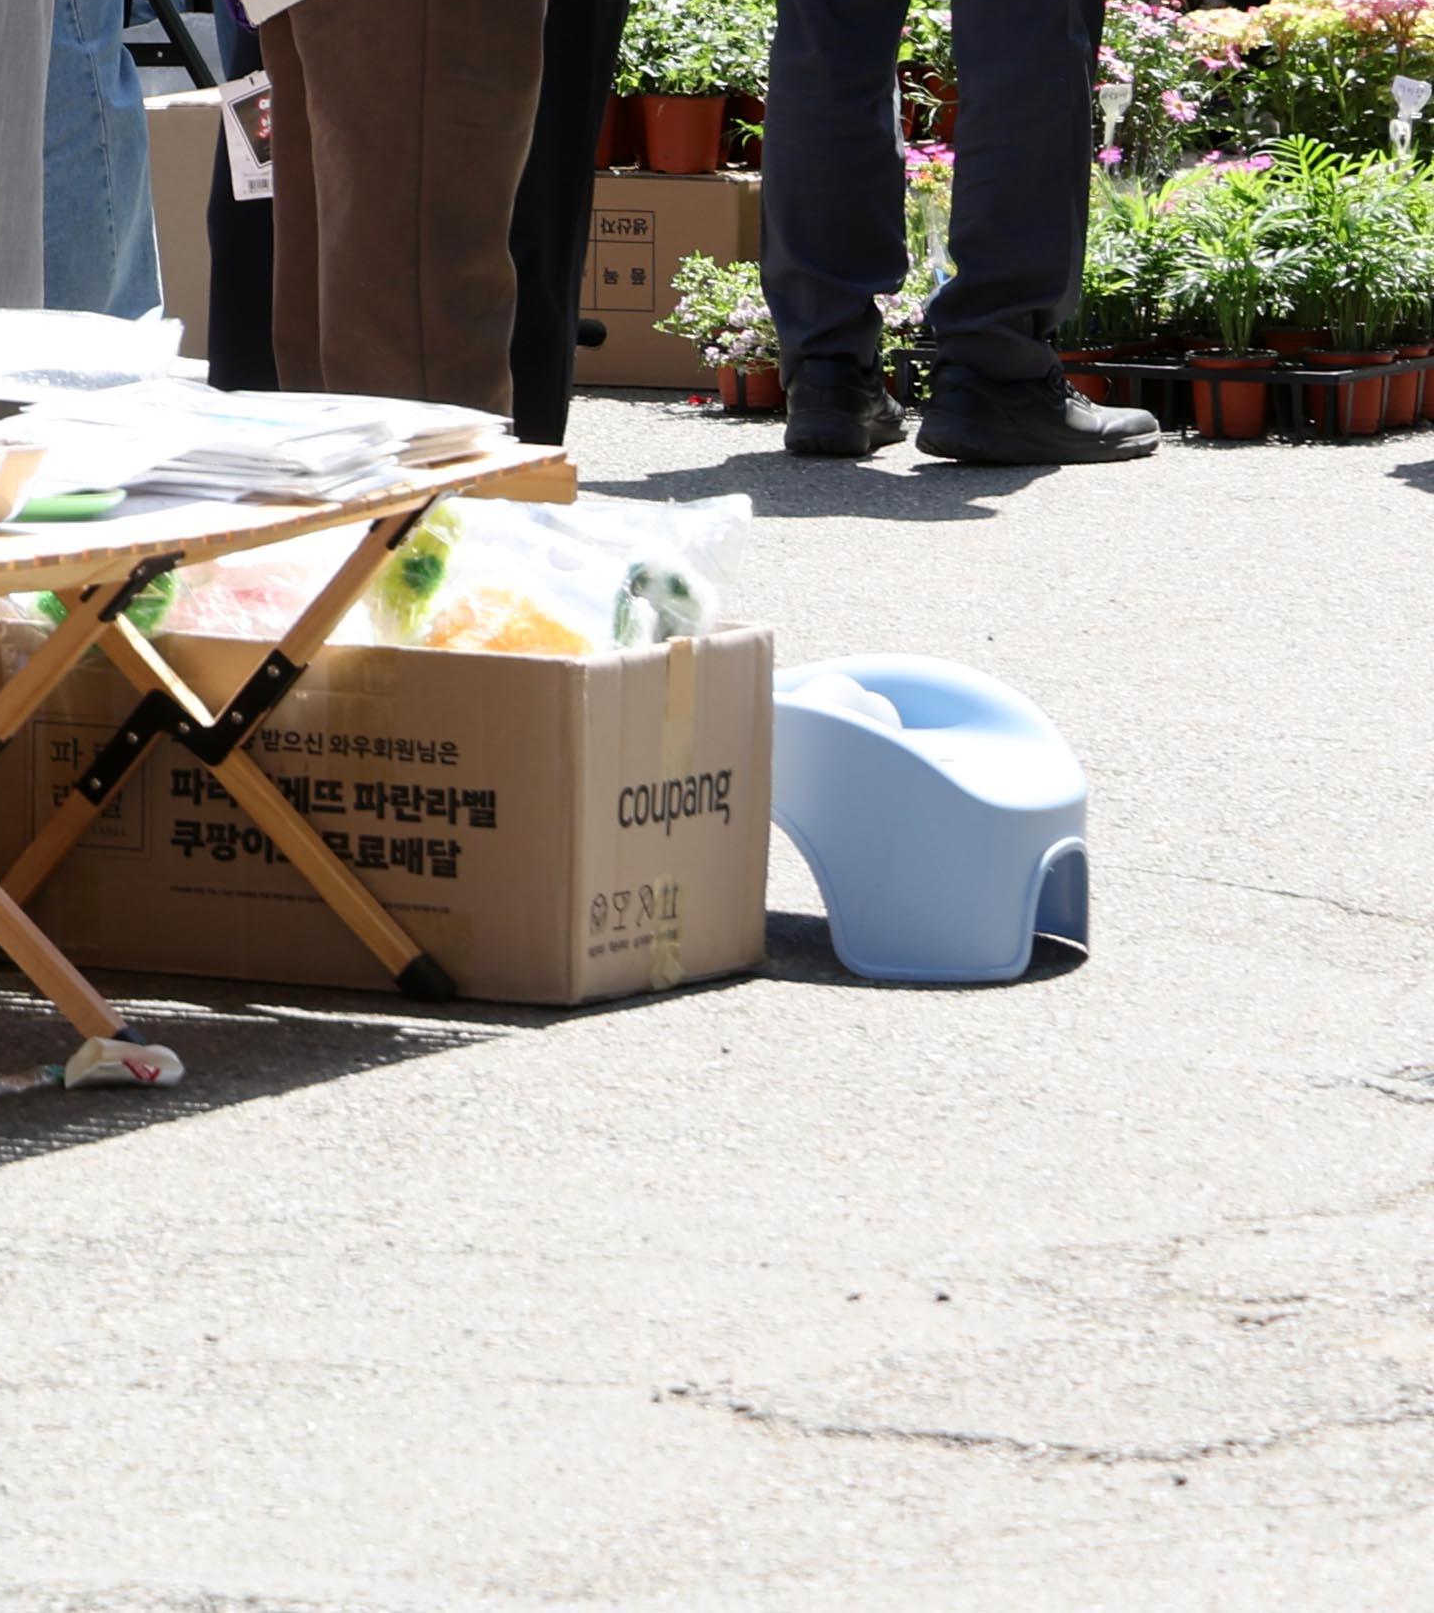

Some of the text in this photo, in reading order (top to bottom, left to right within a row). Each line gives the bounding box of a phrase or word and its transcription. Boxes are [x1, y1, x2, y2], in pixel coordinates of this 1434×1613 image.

[329, 732, 460, 765] 와우회원님은
[353, 780, 497, 829] 파란라벨
[617, 767, 733, 837] coupang
[169, 819, 298, 865] 쿠팡이
